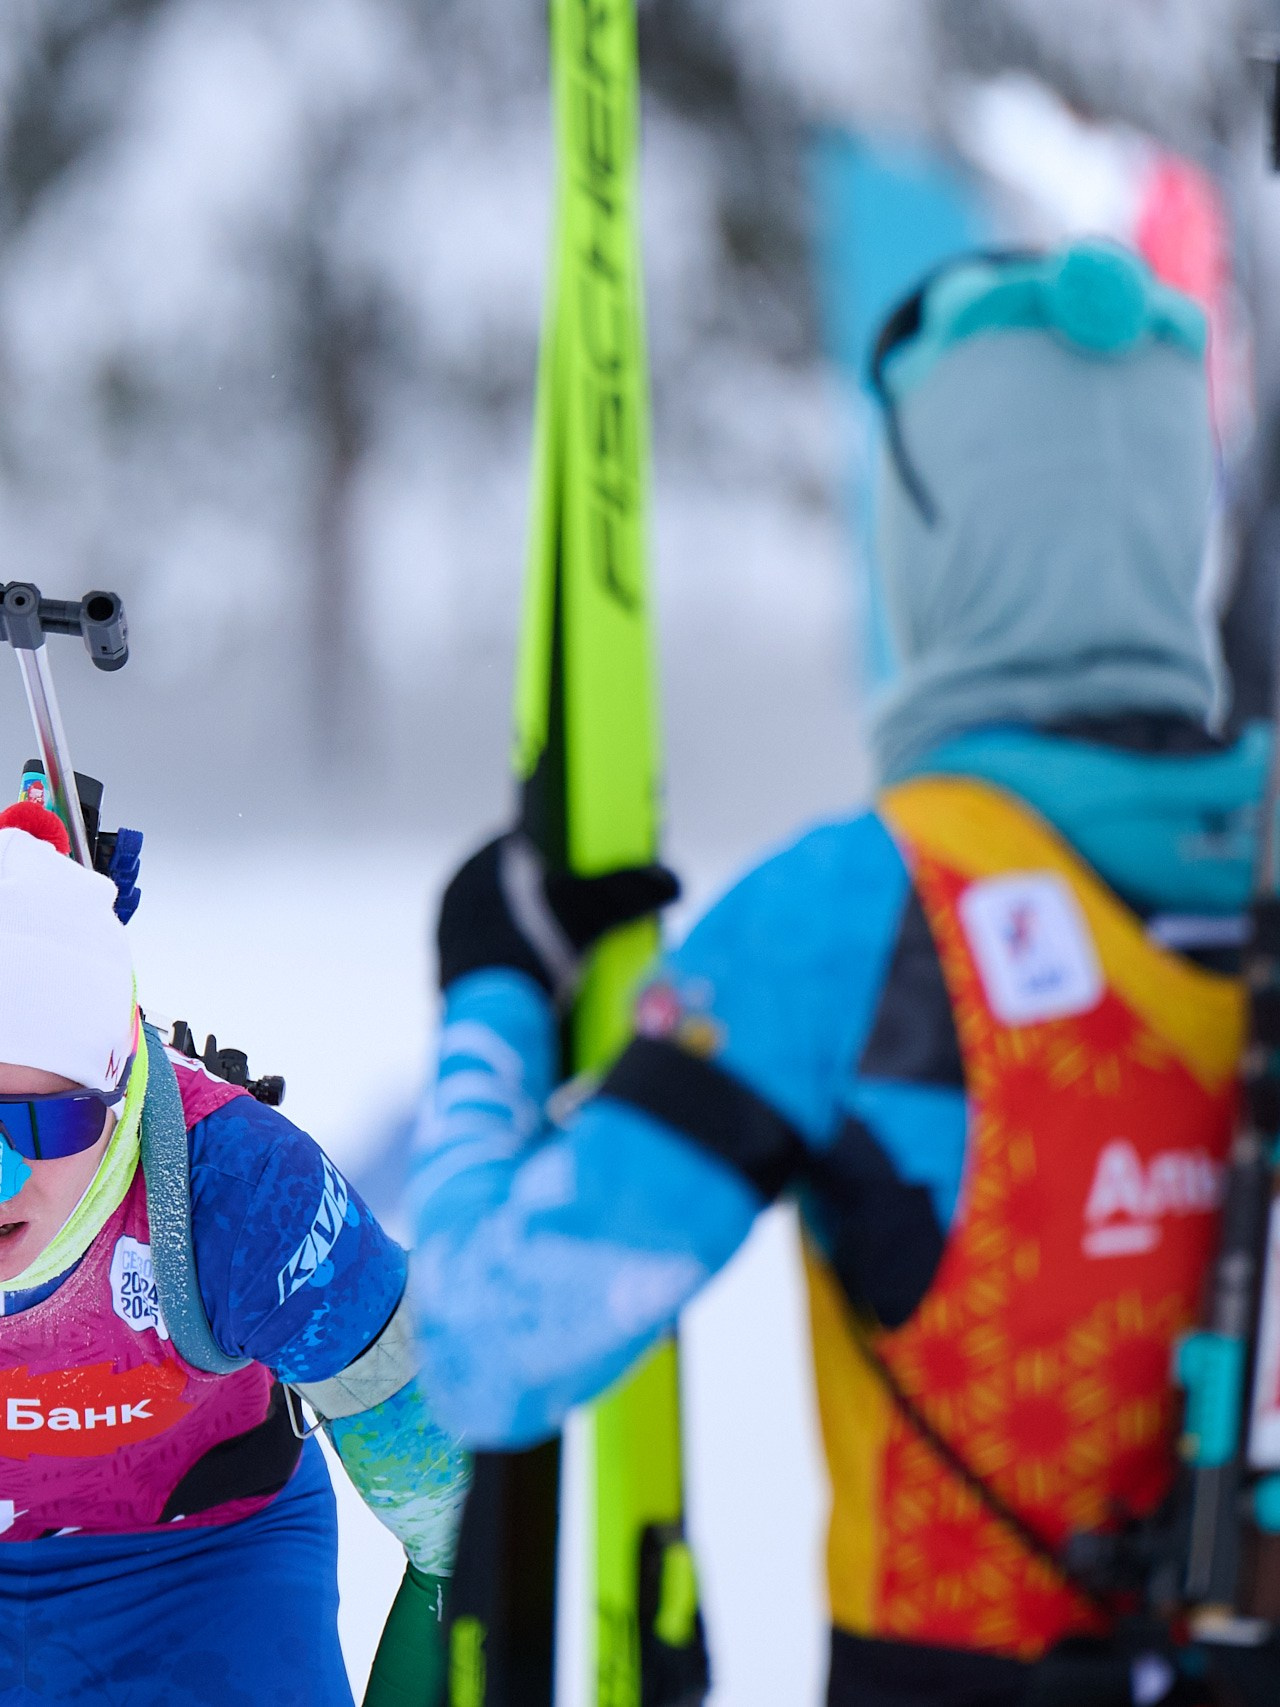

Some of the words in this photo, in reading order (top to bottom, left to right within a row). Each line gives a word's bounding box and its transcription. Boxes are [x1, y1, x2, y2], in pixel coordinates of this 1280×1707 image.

[122, 1250, 152, 1278] СЕЗО
[121, 1271, 159, 1305] 2024
[121, 1295, 159, 1327] 2025
[6, 1397, 154, 1431] Банк
